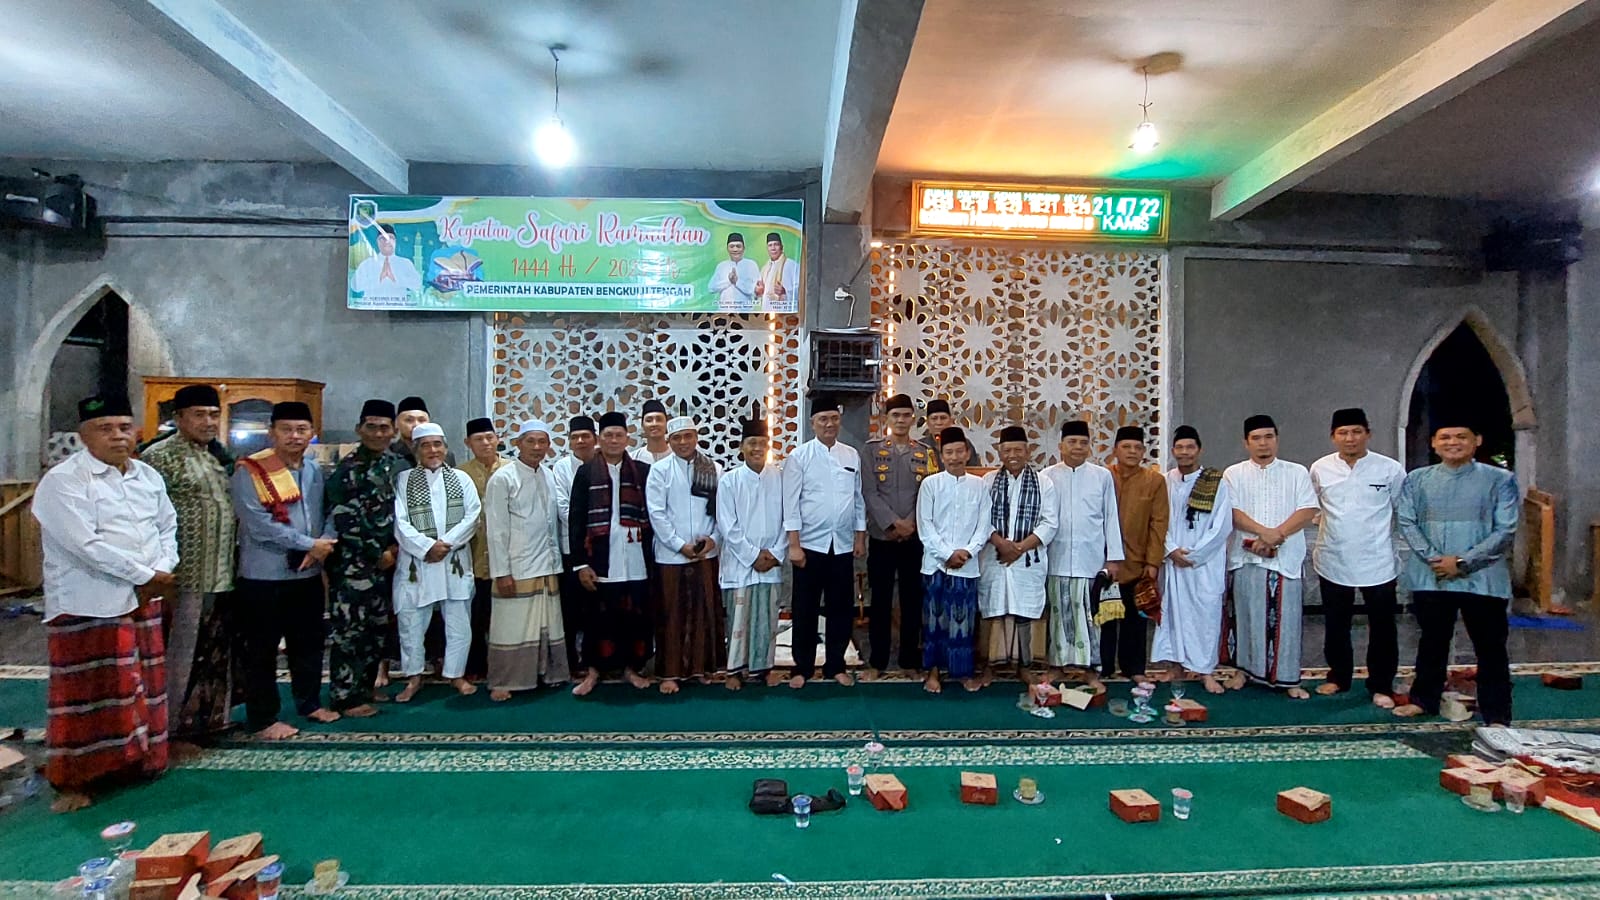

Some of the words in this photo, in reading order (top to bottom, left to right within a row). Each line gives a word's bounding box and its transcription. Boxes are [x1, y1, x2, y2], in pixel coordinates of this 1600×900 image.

[440, 216, 509, 245] Kegiatan
[517, 212, 585, 251] Safari
[598, 214, 704, 245] Ramadhan
[1102, 215, 1149, 231] KAMIS
[512, 257, 549, 278] 1444
[559, 254, 576, 278] H
[585, 256, 599, 274] /
[466, 285, 531, 295] PEMERINTAH
[534, 285, 593, 296] KABUPATEN
[597, 286, 648, 297] BENGKULU
[650, 287, 691, 297] TENGAH
